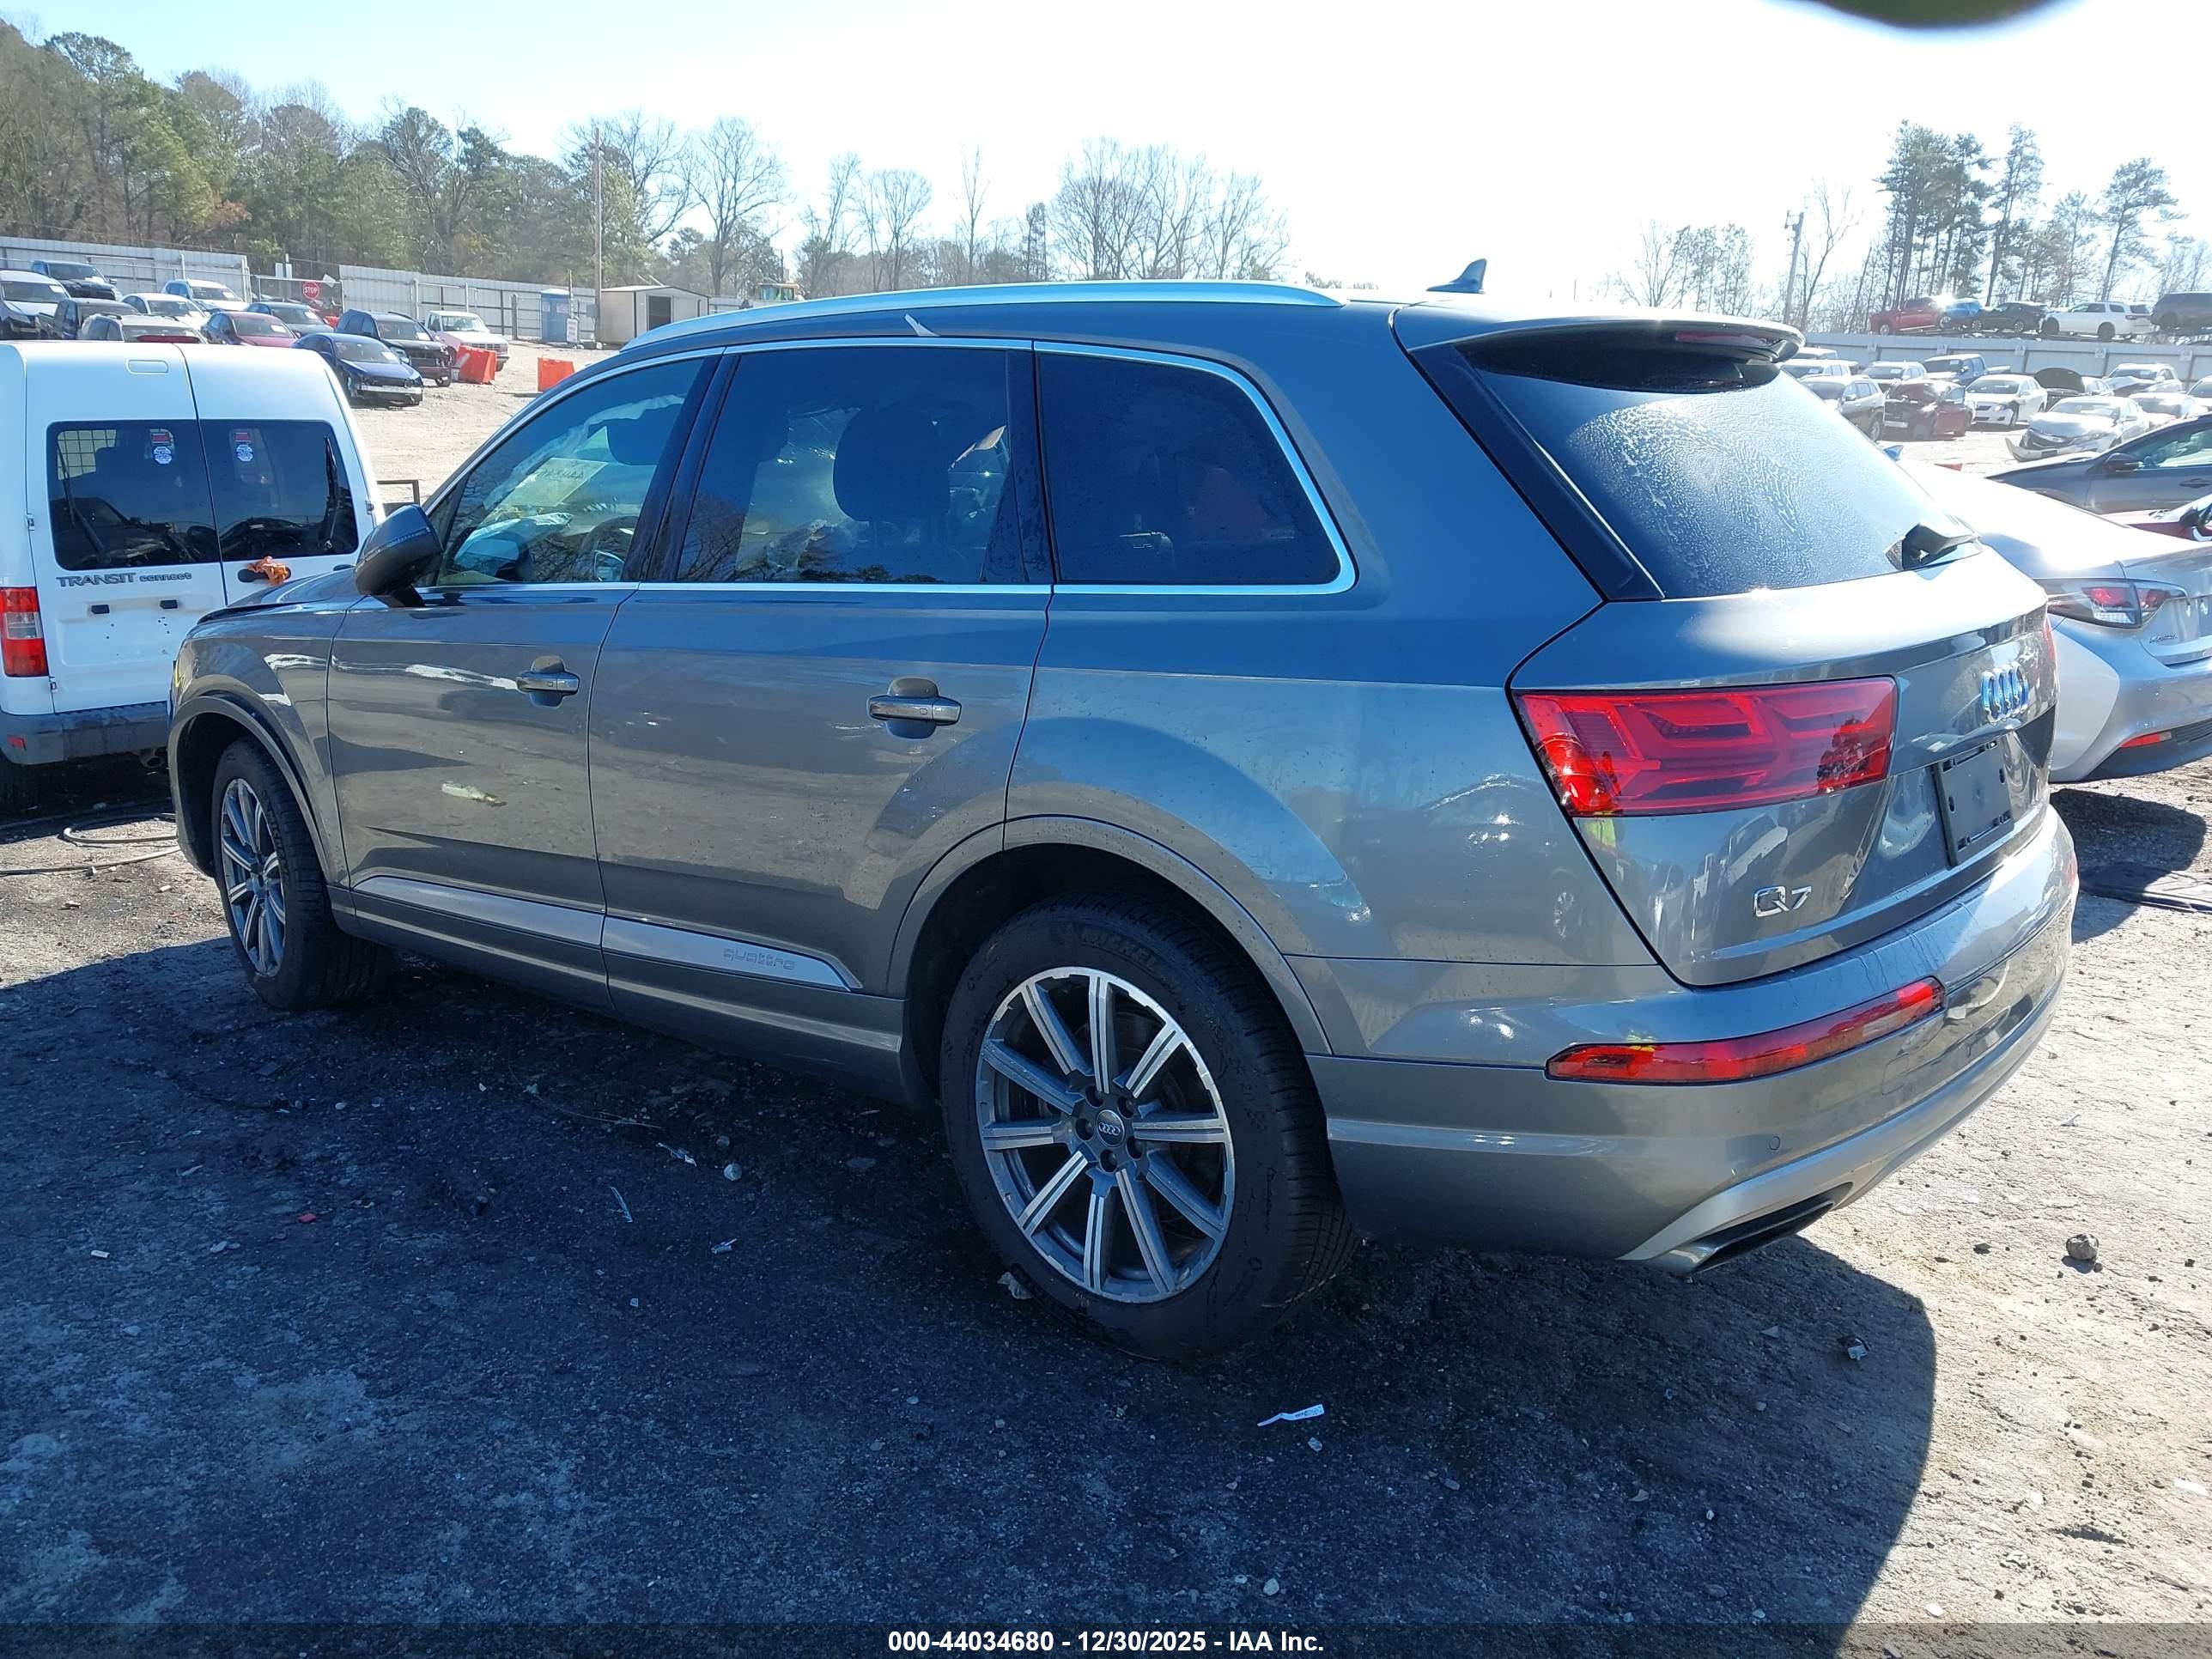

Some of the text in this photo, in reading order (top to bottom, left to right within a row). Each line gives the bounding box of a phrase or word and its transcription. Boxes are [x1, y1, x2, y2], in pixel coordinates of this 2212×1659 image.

[56, 572, 192, 587] TRANSIT connect
[1753, 885, 1812, 918] Q7
[723, 947, 796, 970] quattro
